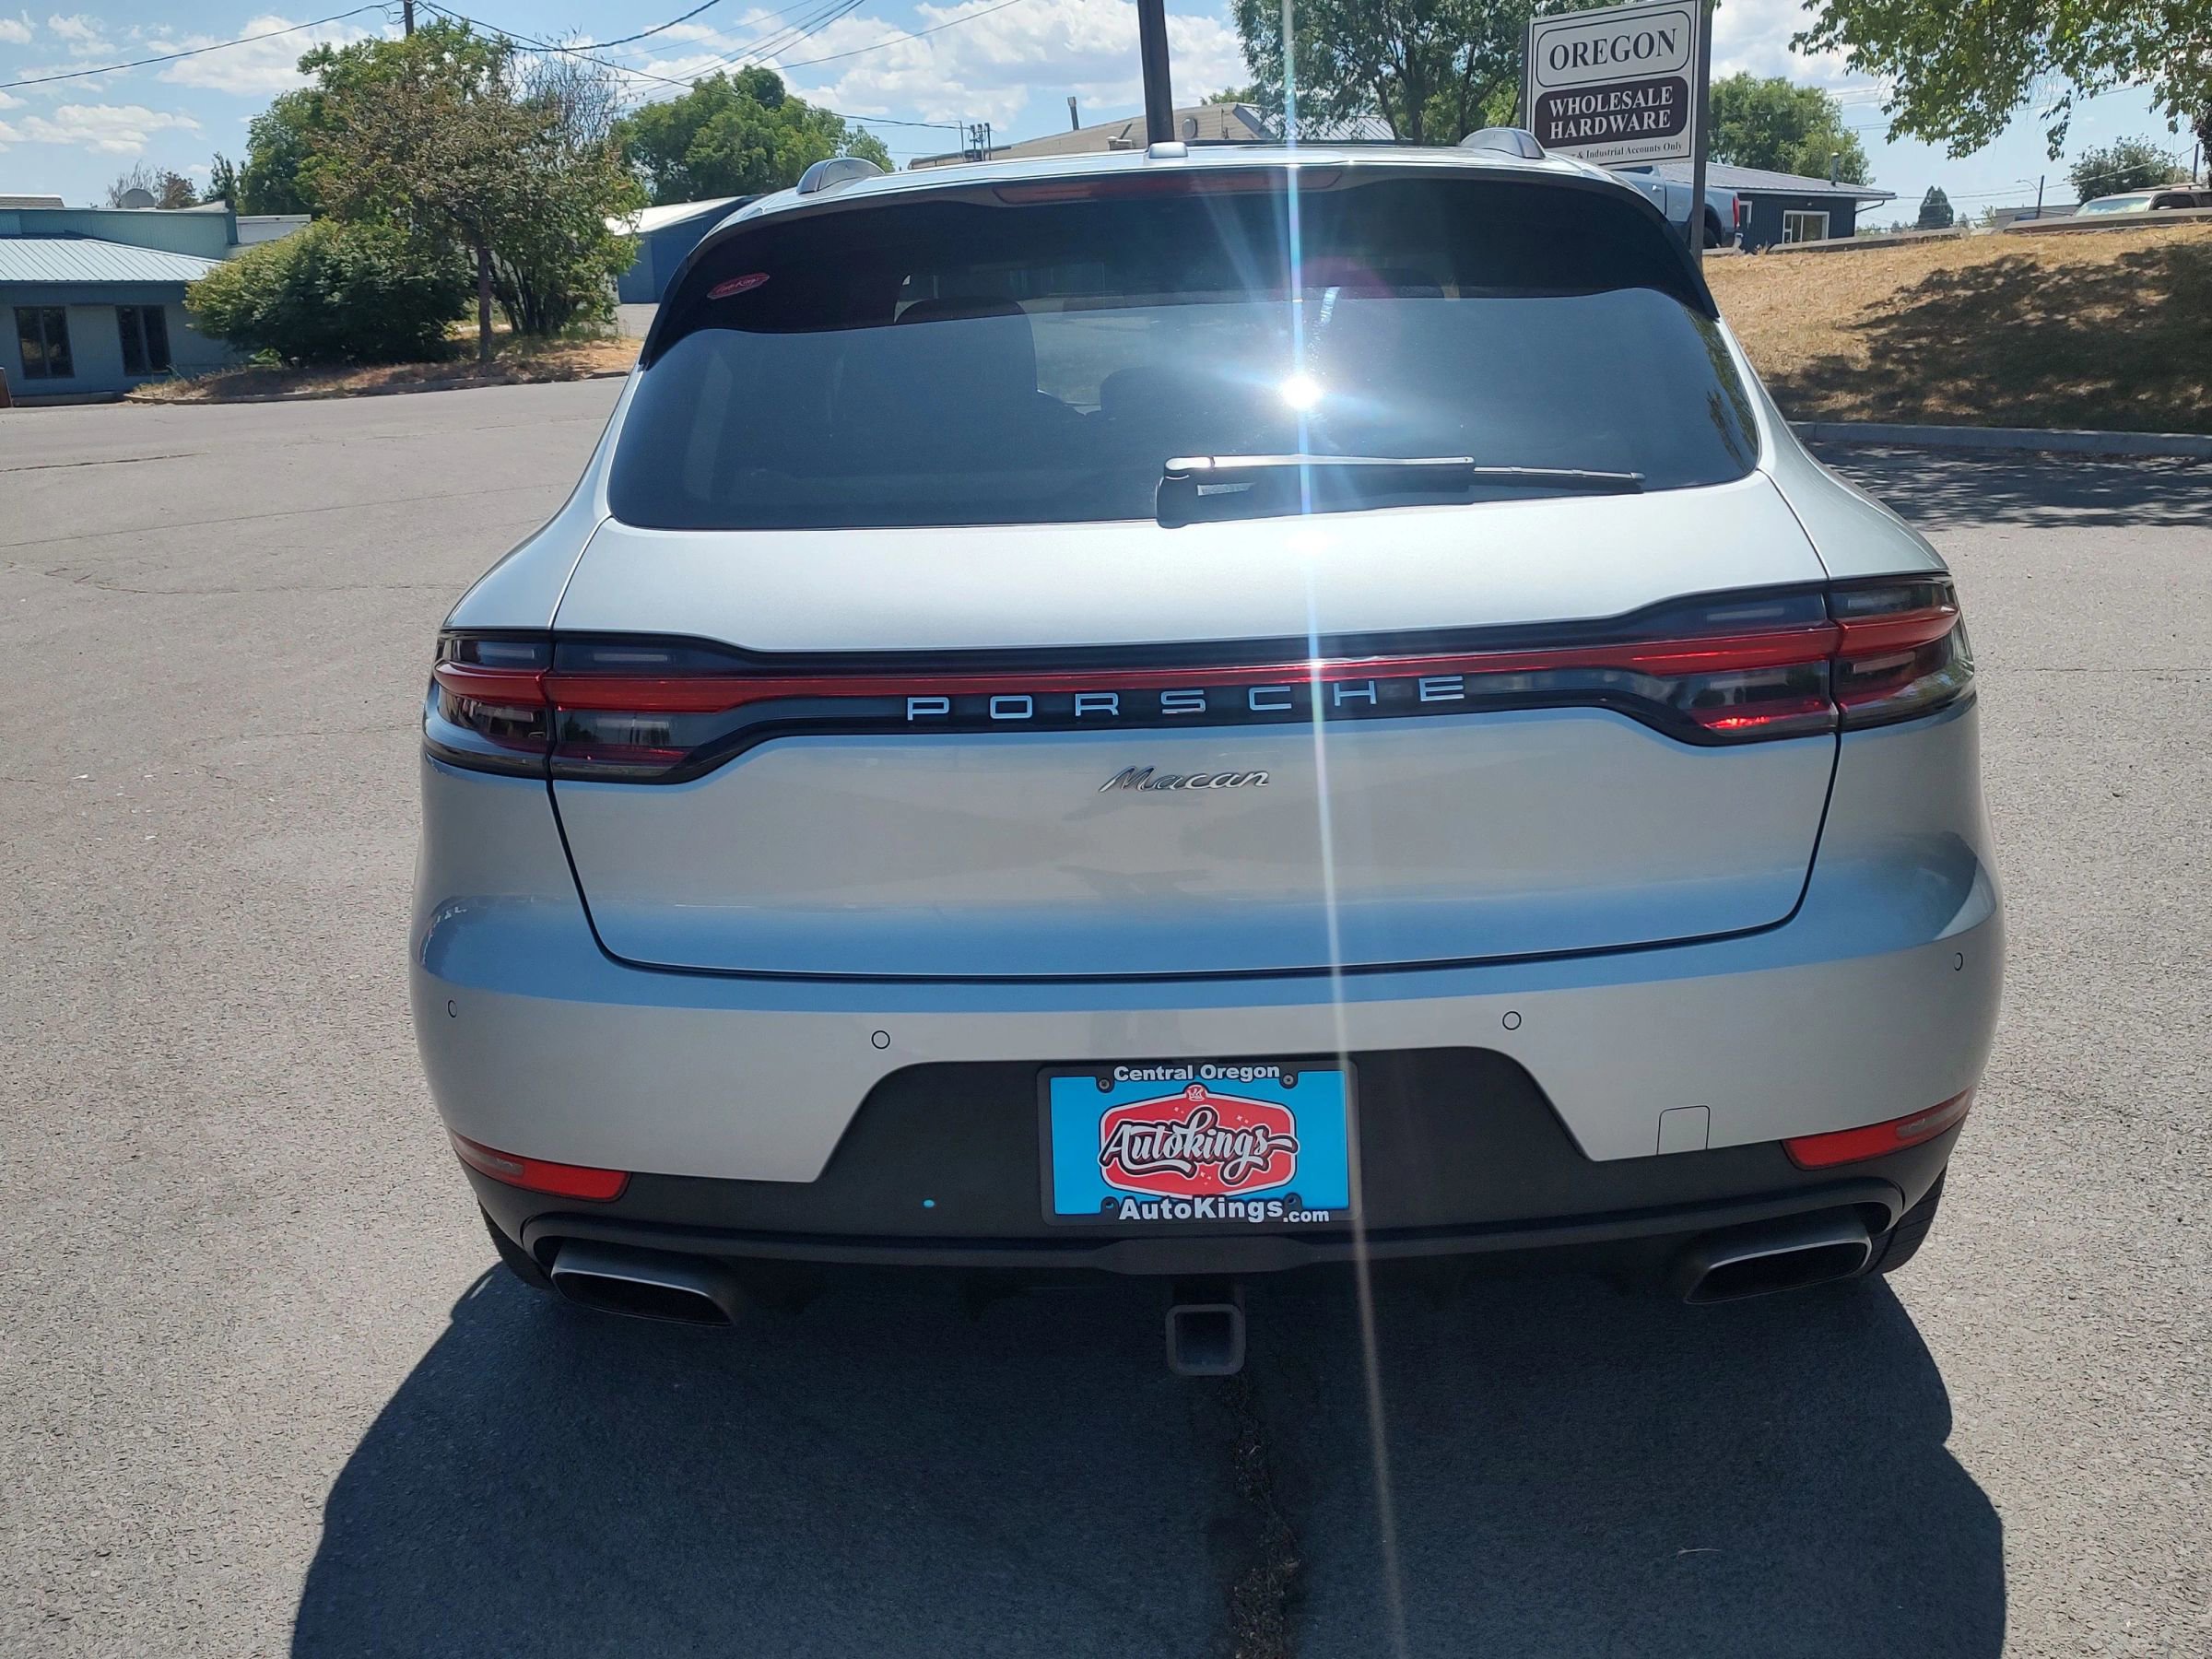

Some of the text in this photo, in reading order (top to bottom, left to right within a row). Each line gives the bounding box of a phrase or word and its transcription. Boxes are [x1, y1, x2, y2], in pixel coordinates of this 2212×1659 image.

[1549, 29, 1677, 70] OREGON
[1549, 86, 1673, 118] WHOLESALE
[1550, 110, 1671, 139] HARDWARE
[1577, 150, 1583, 159] &
[1586, 147, 1624, 159] Industrial
[1626, 143, 1661, 155] Accounts
[1664, 141, 1682, 152] Only
[906, 676, 1465, 721] PORSCHE
[1099, 765, 1270, 793] Macan
[1113, 1065, 1280, 1083] Central Oregon
